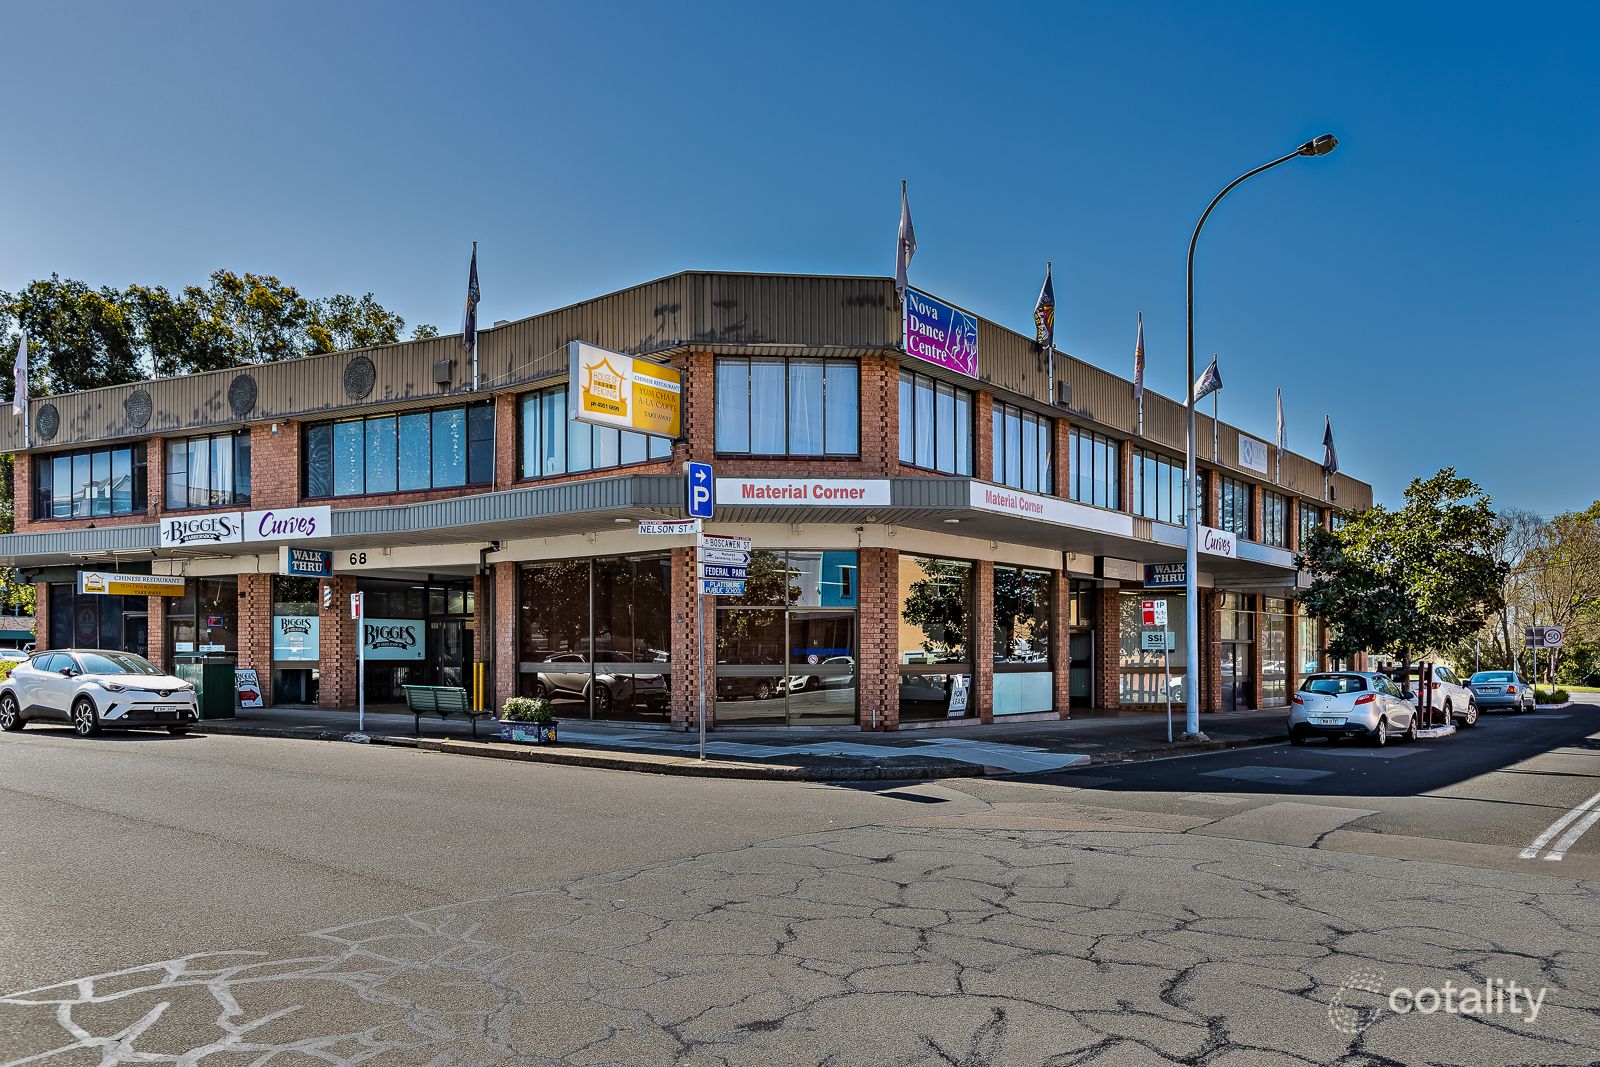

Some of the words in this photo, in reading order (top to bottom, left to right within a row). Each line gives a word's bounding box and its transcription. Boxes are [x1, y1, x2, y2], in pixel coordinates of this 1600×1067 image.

[909, 293, 939, 321] Nova
[909, 314, 945, 342] Dance
[909, 335, 947, 362] Centre
[593, 371, 611, 383] HOUSE
[634, 375, 653, 385] CHINESE
[653, 380, 680, 392] RESTAURANT
[593, 386, 617, 399] PEKING
[640, 387, 654, 398] YUM
[655, 391, 671, 401] CHA
[643, 411, 656, 419] TAKE
[694, 485, 710, 511] P
[742, 484, 807, 498] Material
[813, 485, 866, 499] Corner
[986, 490, 1017, 509] Material
[1020, 497, 1043, 514] Corner
[258, 511, 316, 537] Curves
[640, 525, 674, 533] NELSON
[679, 524, 688, 532] ST
[710, 538, 741, 549] BOSCAWEN
[743, 541, 751, 550] ST
[1204, 529, 1231, 555] Curves
[292, 550, 323, 562] WALK
[349, 552, 367, 565] 68
[292, 560, 323, 573] THRU
[705, 566, 730, 577] FEDERAL
[732, 568, 747, 578] PARK
[1154, 563, 1185, 574] WALK
[142, 576, 181, 584] RESTAURANT
[1154, 573, 1186, 583] THRU
[281, 618, 312, 630] BIGGES
[363, 624, 417, 647] BIGGES
[953, 690, 963, 698] FOR
